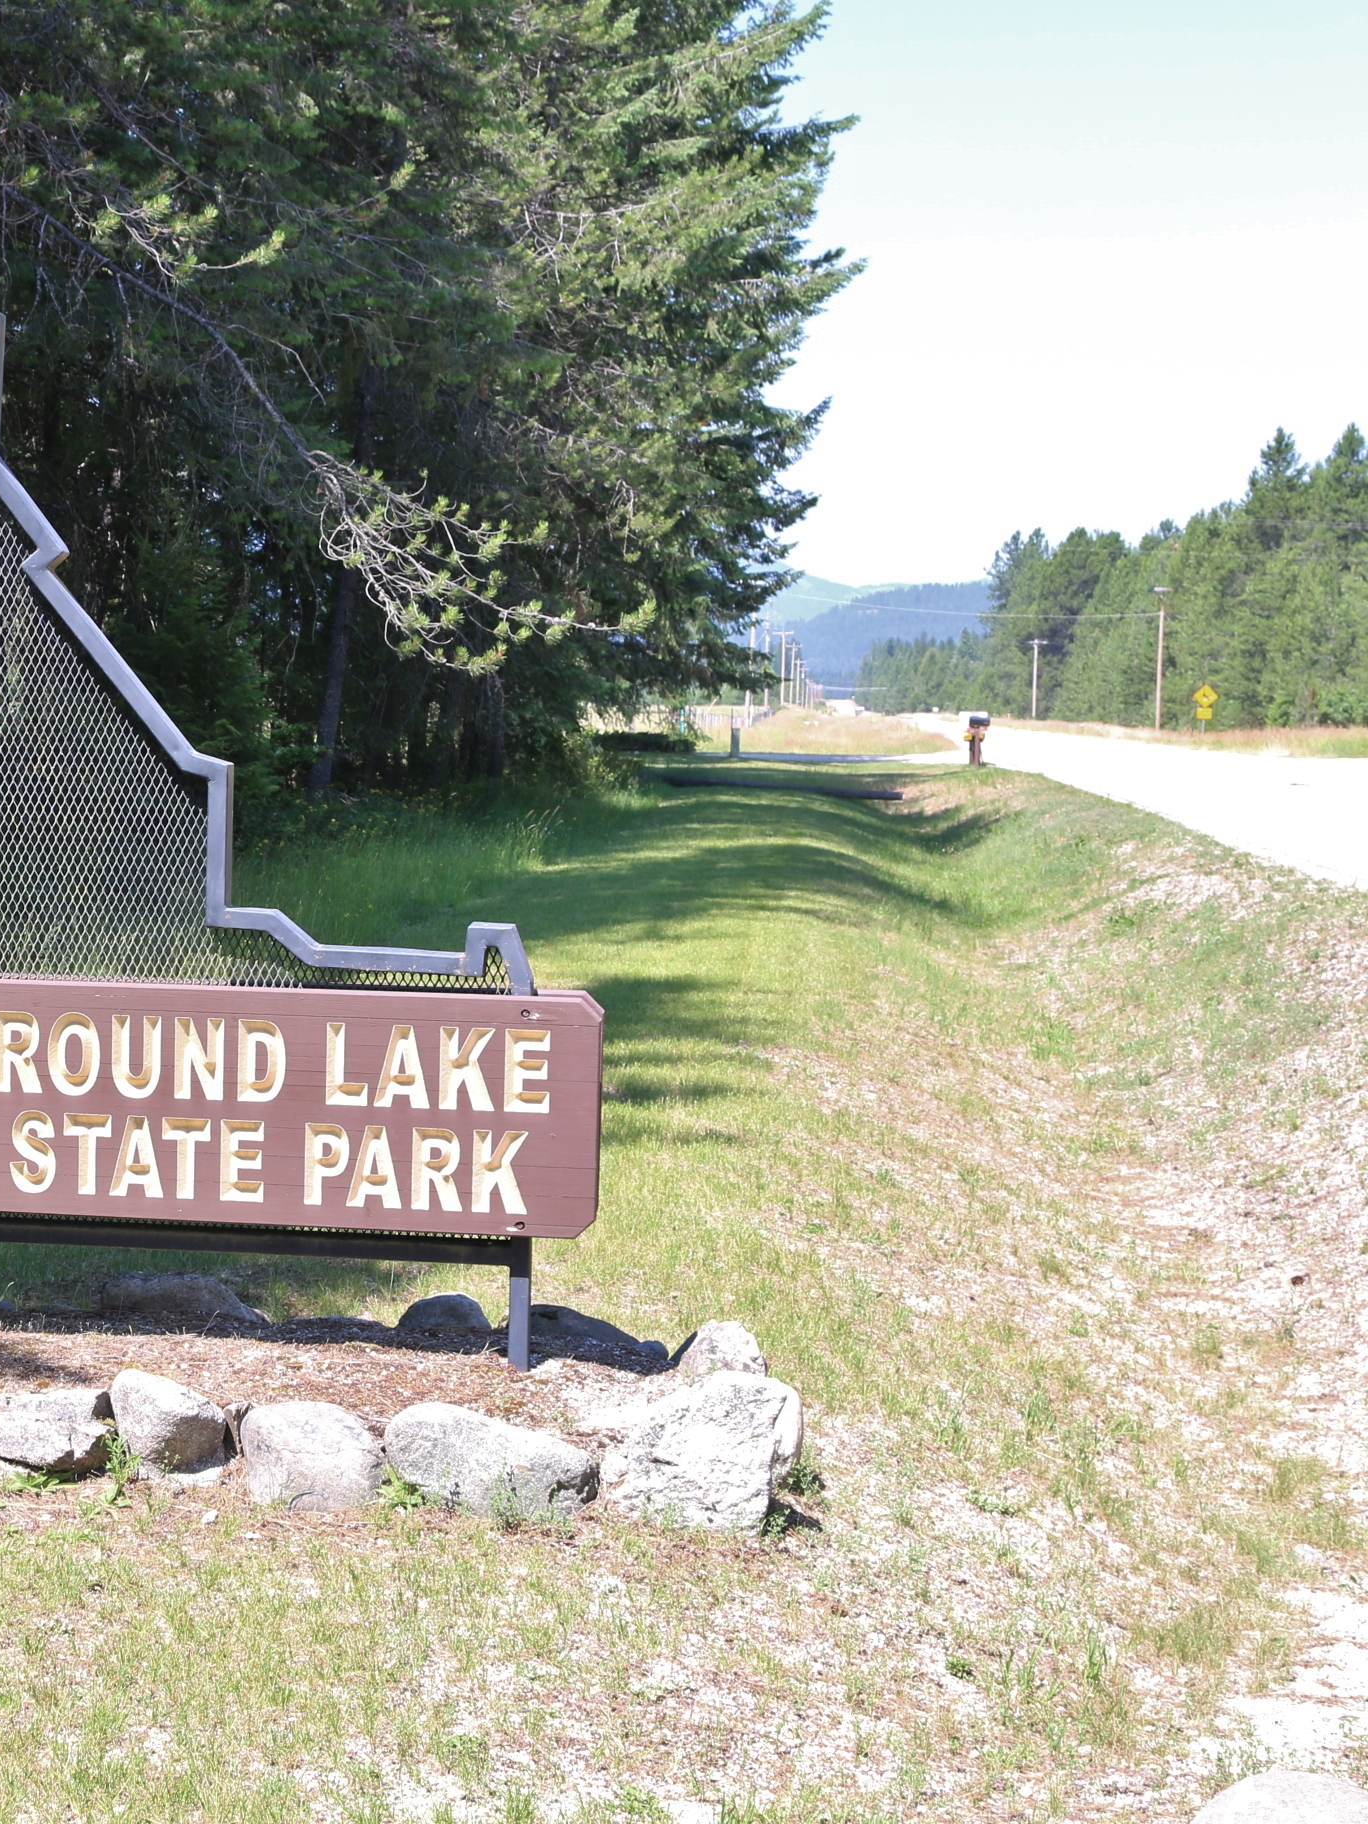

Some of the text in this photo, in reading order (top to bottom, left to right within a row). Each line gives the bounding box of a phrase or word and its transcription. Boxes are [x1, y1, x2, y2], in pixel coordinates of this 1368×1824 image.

[325, 1022, 550, 1114] LAKE
[9, 1110, 529, 1215] STATE PARK
